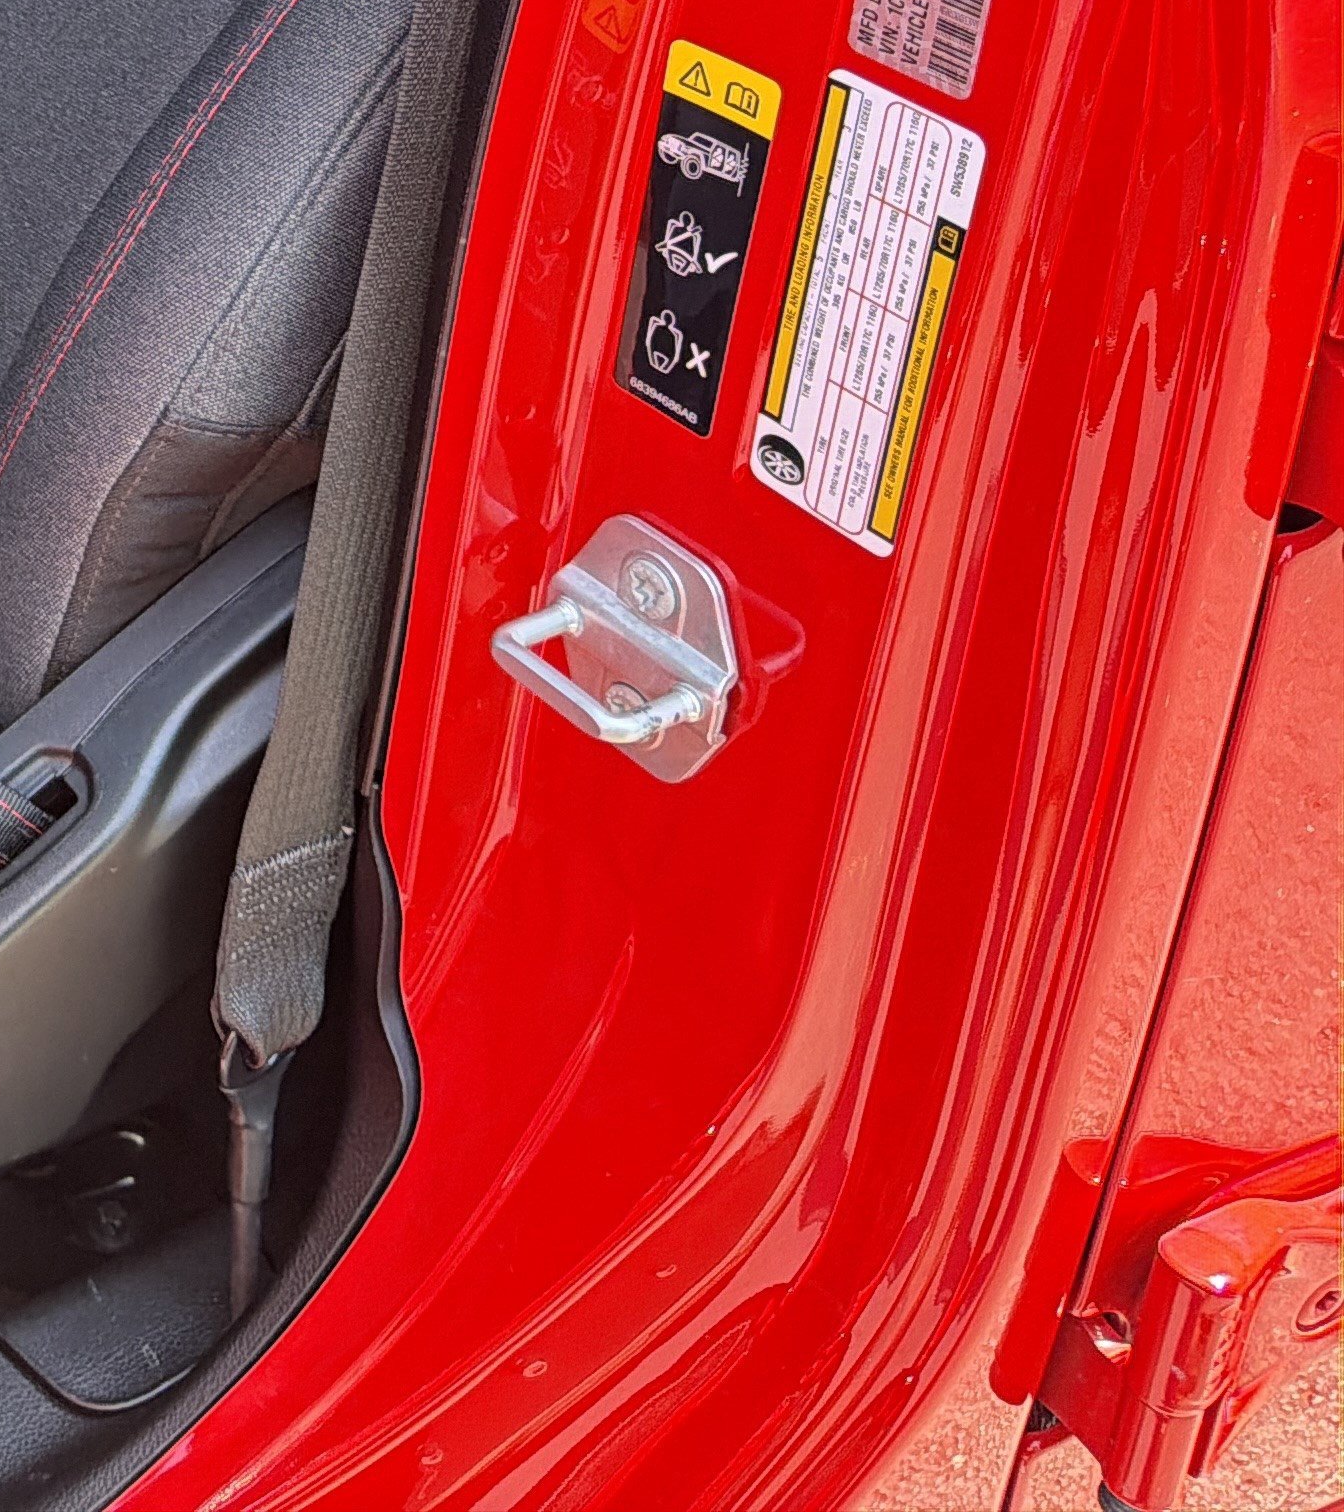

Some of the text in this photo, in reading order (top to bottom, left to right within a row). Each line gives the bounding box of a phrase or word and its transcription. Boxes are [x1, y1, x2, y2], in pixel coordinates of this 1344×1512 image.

[857, 6, 879, 47] MFD
[878, 19, 900, 56] VIN:
[949, 137, 972, 198] SW538912
[801, 172, 824, 242] INFORMATION
[792, 241, 809, 286] LOADING
[788, 284, 800, 308] AND
[783, 307, 796, 332] TIRE
